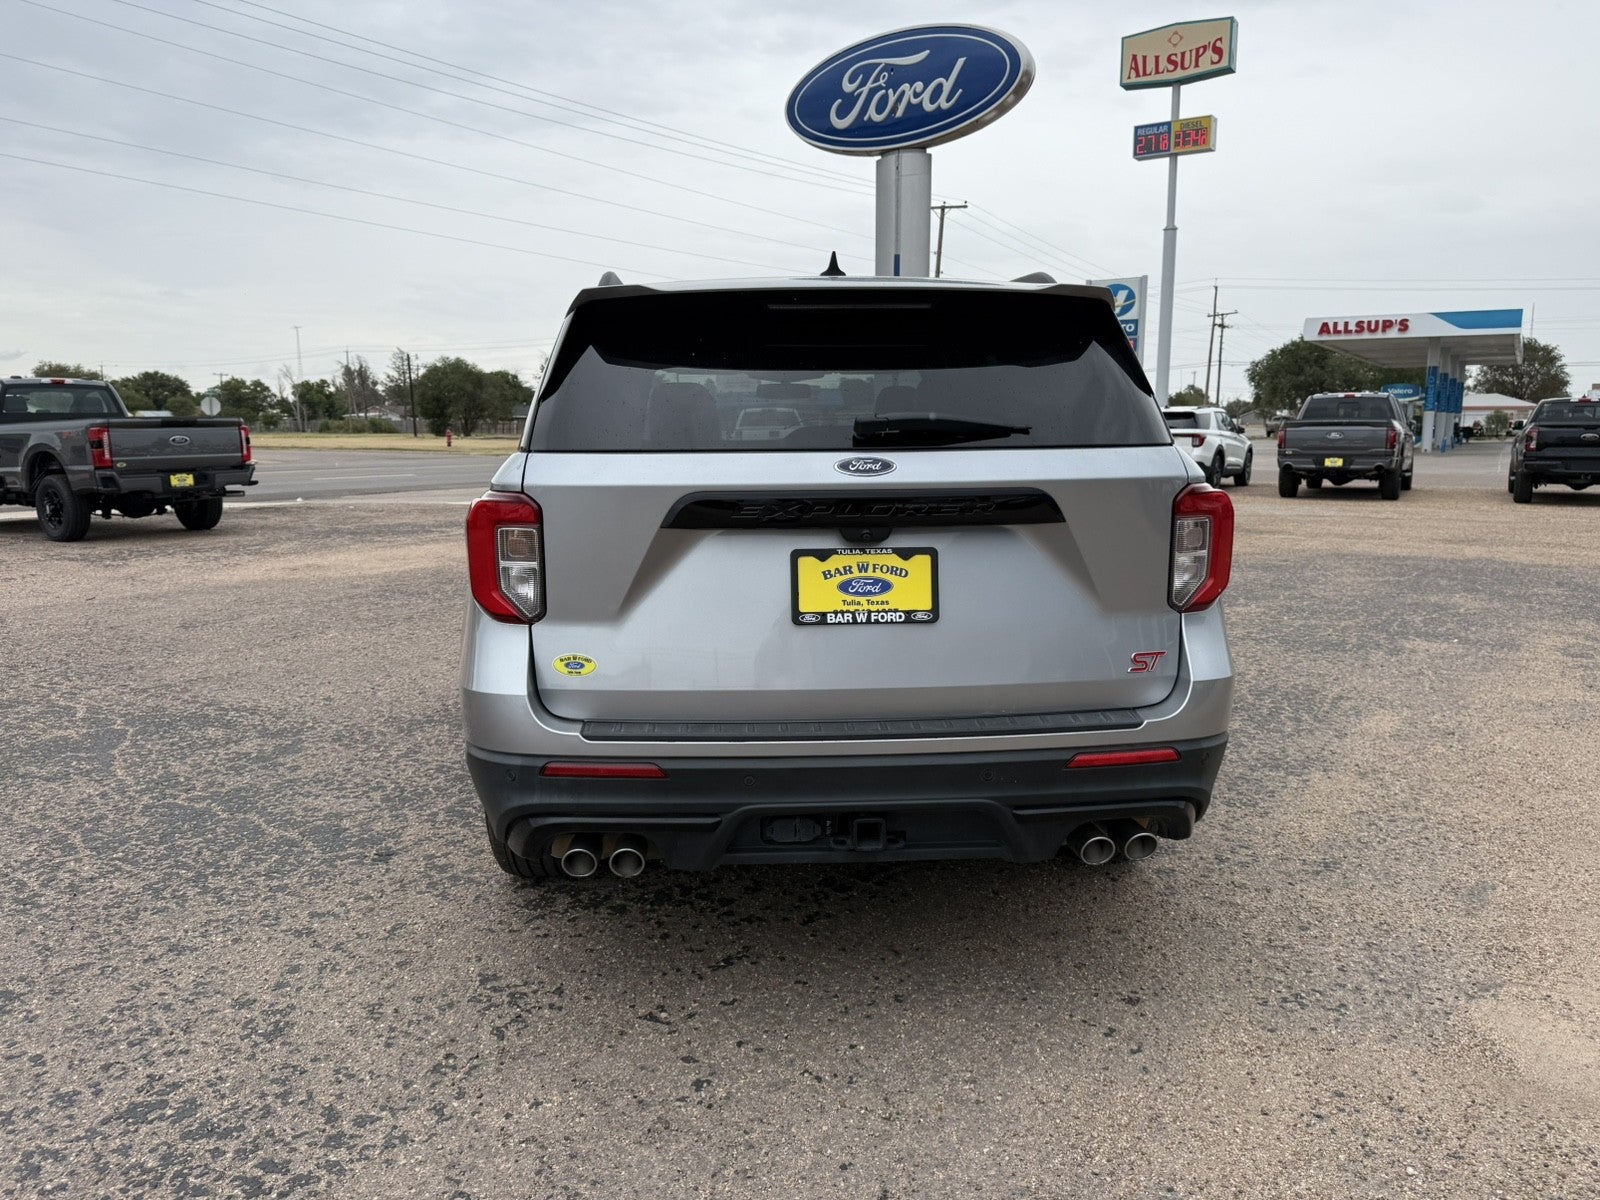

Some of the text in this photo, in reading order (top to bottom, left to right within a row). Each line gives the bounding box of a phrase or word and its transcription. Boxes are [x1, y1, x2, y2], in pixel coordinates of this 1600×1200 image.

[1127, 37, 1224, 79] ALLSUP'S
[829, 50, 967, 130] Ford
[1137, 125, 1168, 136] REGULAR
[1180, 120, 1203, 129] DIESEL
[1318, 318, 1410, 335] ALLSUP'S
[849, 459, 882, 470] Ford
[730, 501, 997, 521] EXPLORER
[821, 561, 909, 580] BAR W FORD
[848, 579, 882, 593] Ford
[841, 599, 864, 607] Tulia,
[826, 612, 853, 623] BAR
[854, 611, 868, 623] W
[871, 611, 905, 623] FORD
[1127, 651, 1167, 673] ST
